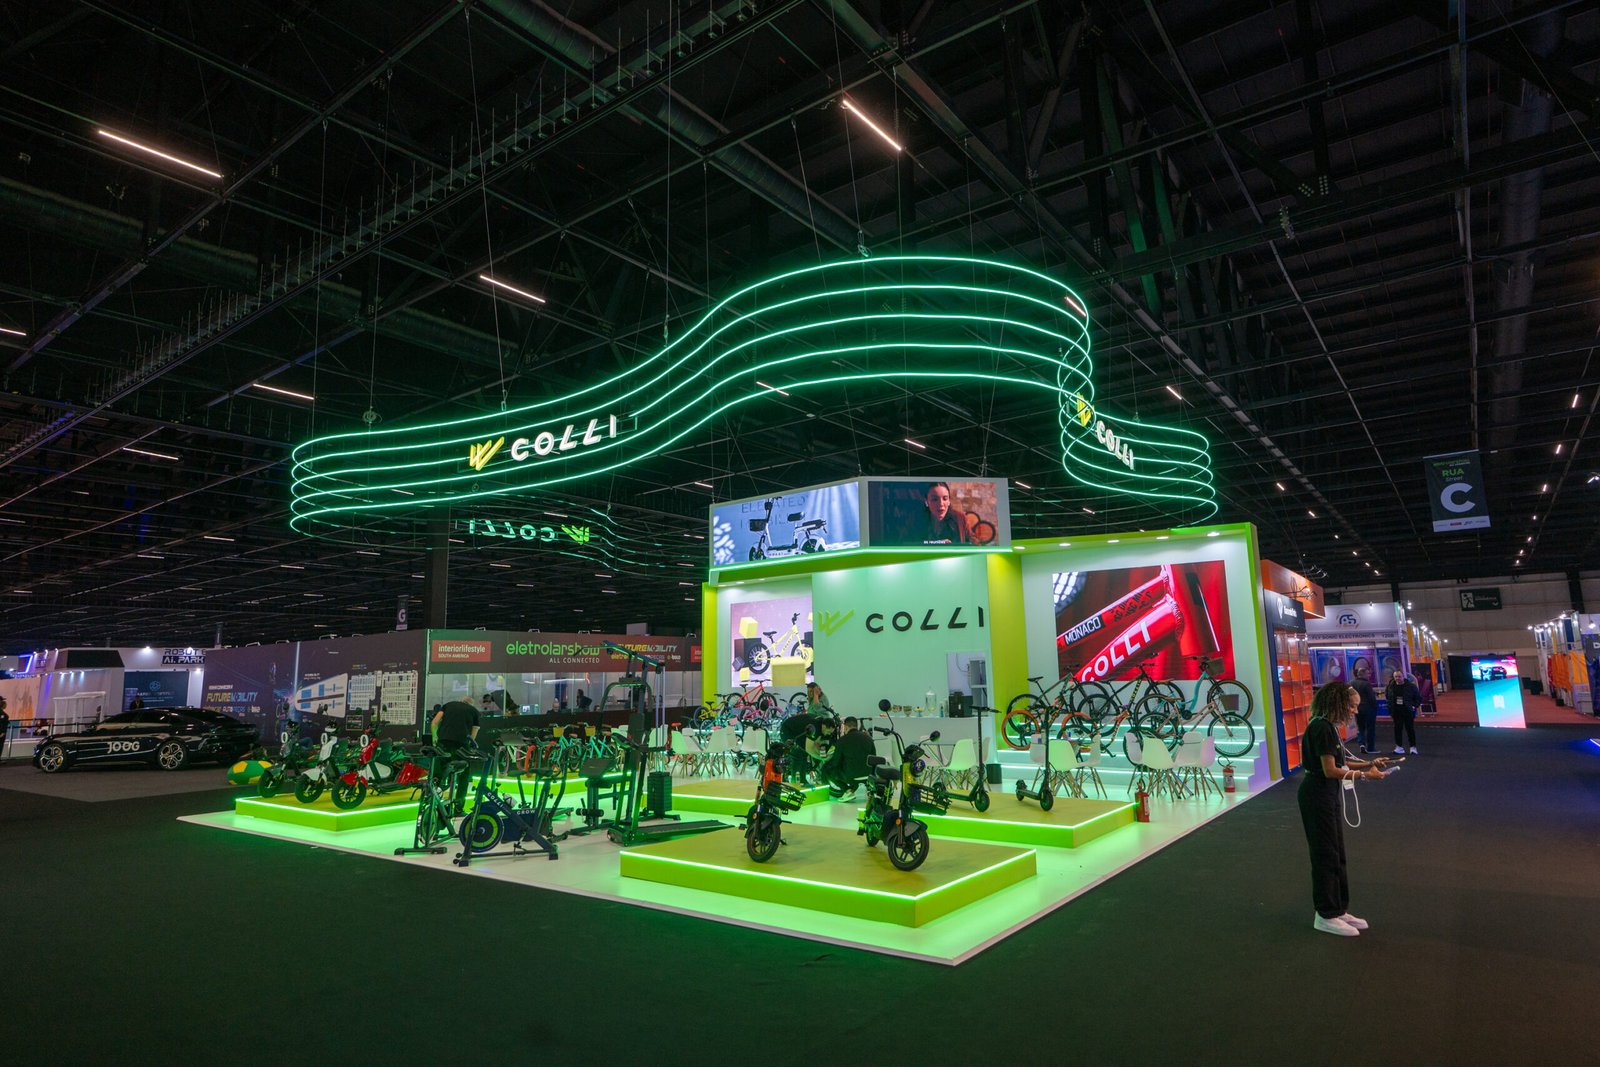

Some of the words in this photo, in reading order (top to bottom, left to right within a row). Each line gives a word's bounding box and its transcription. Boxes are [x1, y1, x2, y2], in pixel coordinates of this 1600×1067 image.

[511, 414, 617, 461] COLLI
[1096, 420, 1135, 470] COLLI
[1442, 468, 1464, 477] RUA
[741, 496, 806, 514] ELEATED
[1440, 482, 1476, 513] C
[399, 608, 406, 622] G
[865, 605, 985, 634] COLLI
[1065, 616, 1101, 646] MONACO
[438, 644, 486, 654] interiorlifestyle
[506, 641, 600, 656] eletrolarshow
[1082, 621, 1151, 682] COLLI
[107, 741, 140, 754] JOOG
